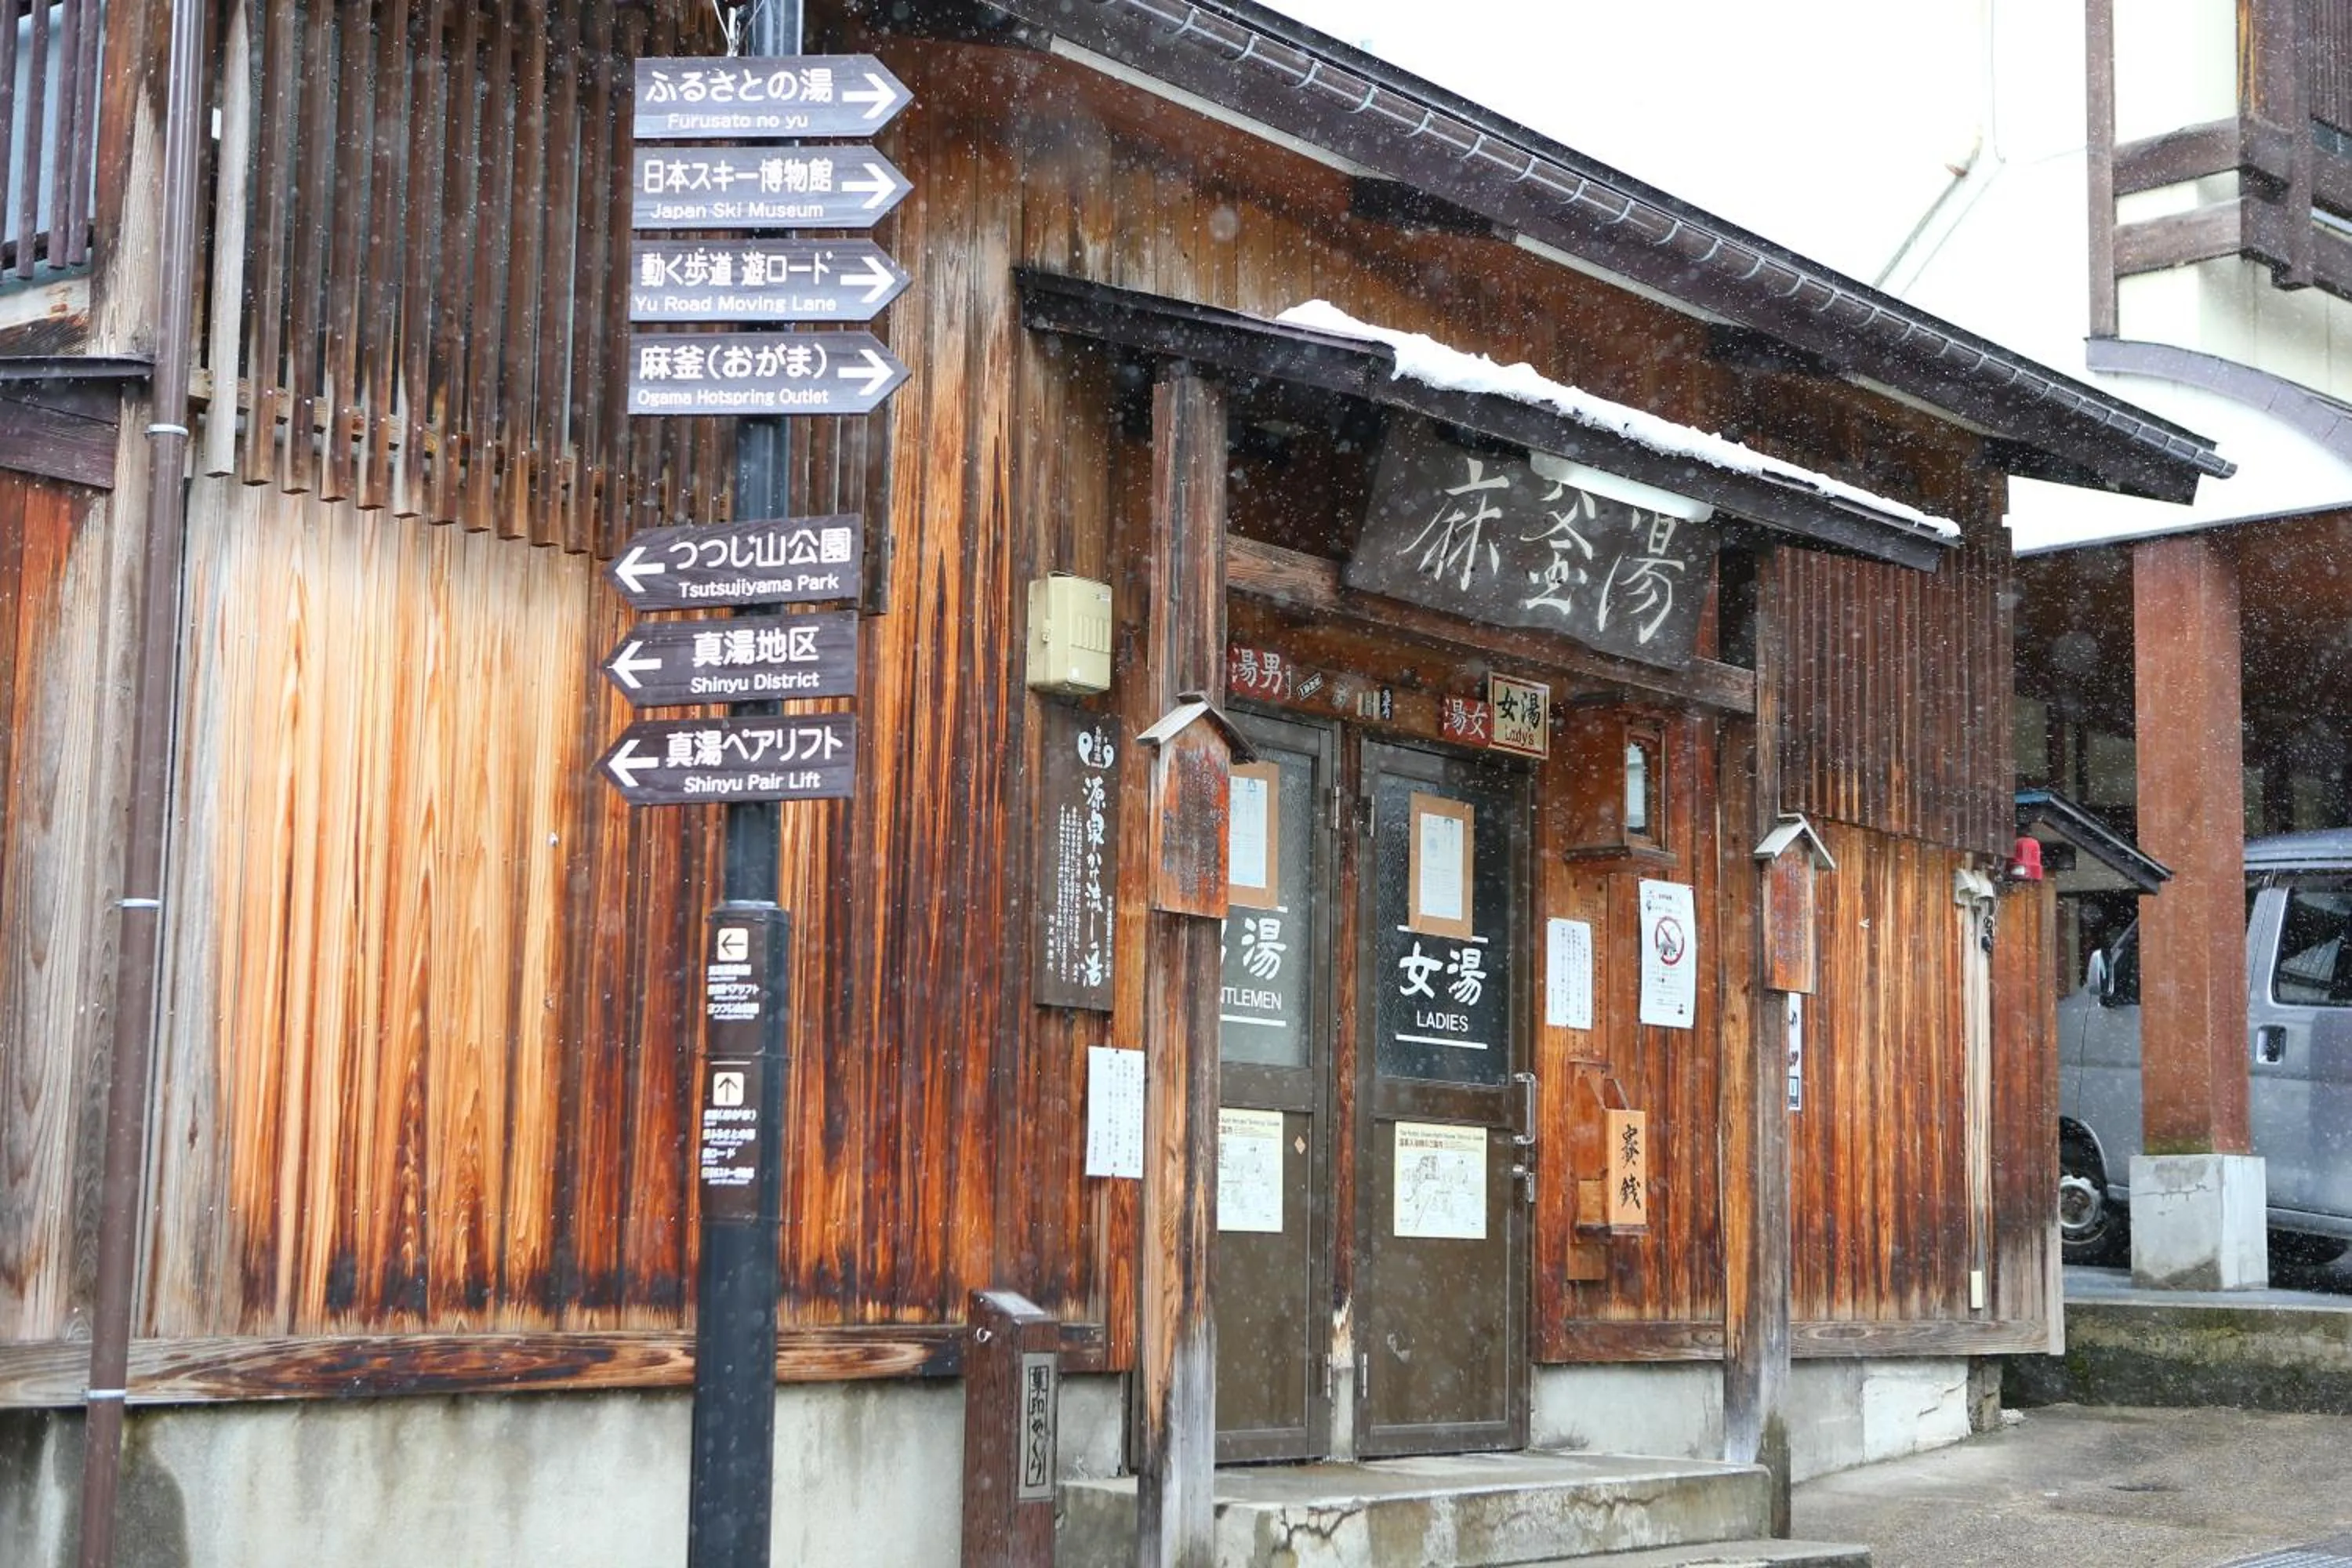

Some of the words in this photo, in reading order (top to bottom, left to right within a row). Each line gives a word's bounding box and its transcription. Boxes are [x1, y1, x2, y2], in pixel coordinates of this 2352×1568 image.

[646, 69, 833, 103] ふるさとの湯
[667, 113, 752, 130] Furusato
[757, 116, 780, 129] no
[786, 116, 808, 133] yu
[644, 159, 833, 193] 日本スキー博物館
[650, 202, 706, 220] Japan
[713, 202, 742, 219] Ski
[749, 202, 823, 219] Museum
[641, 251, 732, 287] 動く歩道
[742, 251, 833, 287] 遊ロード
[635, 296, 658, 312] Yu
[664, 295, 712, 311] Road
[718, 295, 785, 314] Moving
[793, 296, 837, 312] Lane
[637, 390, 691, 408] Ogama
[697, 390, 774, 407] Hotspring
[779, 388, 829, 405] Outlet
[668, 527, 851, 570] つつじ山公園
[679, 579, 792, 599] Tsutsujiyama
[797, 573, 839, 591] Park
[692, 626, 819, 667] 真湯地区
[690, 677, 749, 694] Shinyu
[753, 671, 819, 691] District
[1497, 686, 1541, 728] 女湯
[666, 725, 844, 768] 真湯ペアリフト
[684, 779, 742, 797] Shinyu
[747, 775, 783, 791] Pair
[789, 772, 821, 789] Lift
[1221, 917, 1287, 981] 湯
[1399, 941, 1486, 1006] 女湯
[1417, 1011, 1468, 1033] LADIES
